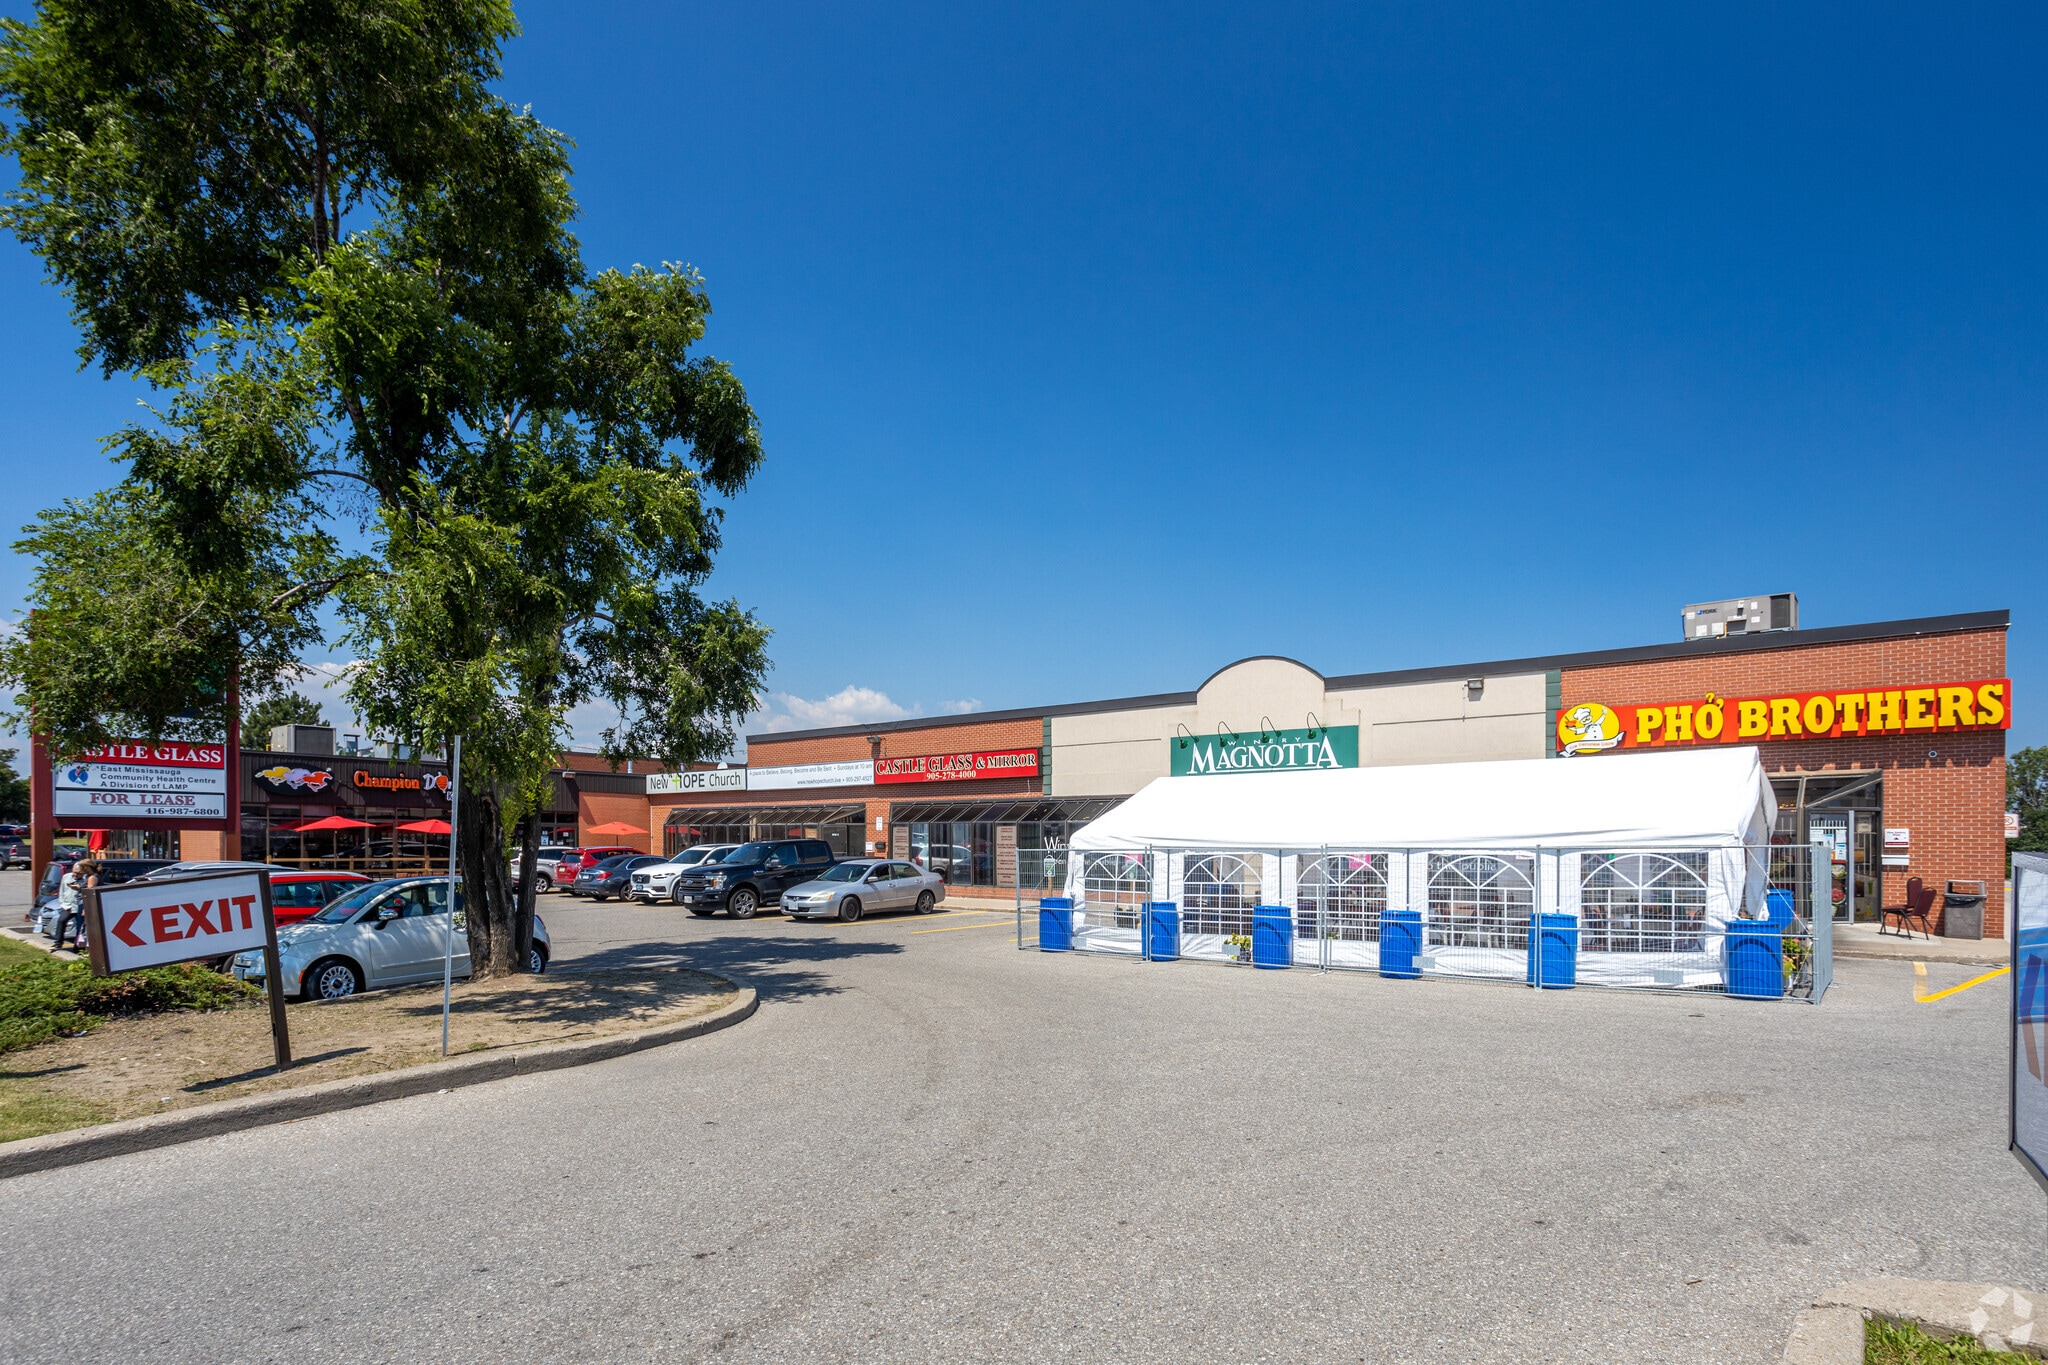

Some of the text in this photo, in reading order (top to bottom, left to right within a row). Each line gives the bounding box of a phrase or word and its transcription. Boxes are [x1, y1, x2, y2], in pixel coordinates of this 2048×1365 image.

[1738, 683, 2005, 738] BROTHERS
[1227, 737, 1301, 746] WINERY
[154, 746, 221, 763] GLASS
[124, 766, 181, 776] Mississauga
[876, 753, 1036, 775] CASTLE GLASS & MIRROR
[100, 773, 216, 784] Community Health Centre
[354, 770, 420, 791] Champion
[650, 776, 669, 789] New
[709, 772, 741, 787] Church
[926, 770, 977, 780] 905-278-4000
[89, 793, 195, 806] FOR LEASE
[150, 894, 256, 943] EXIT
